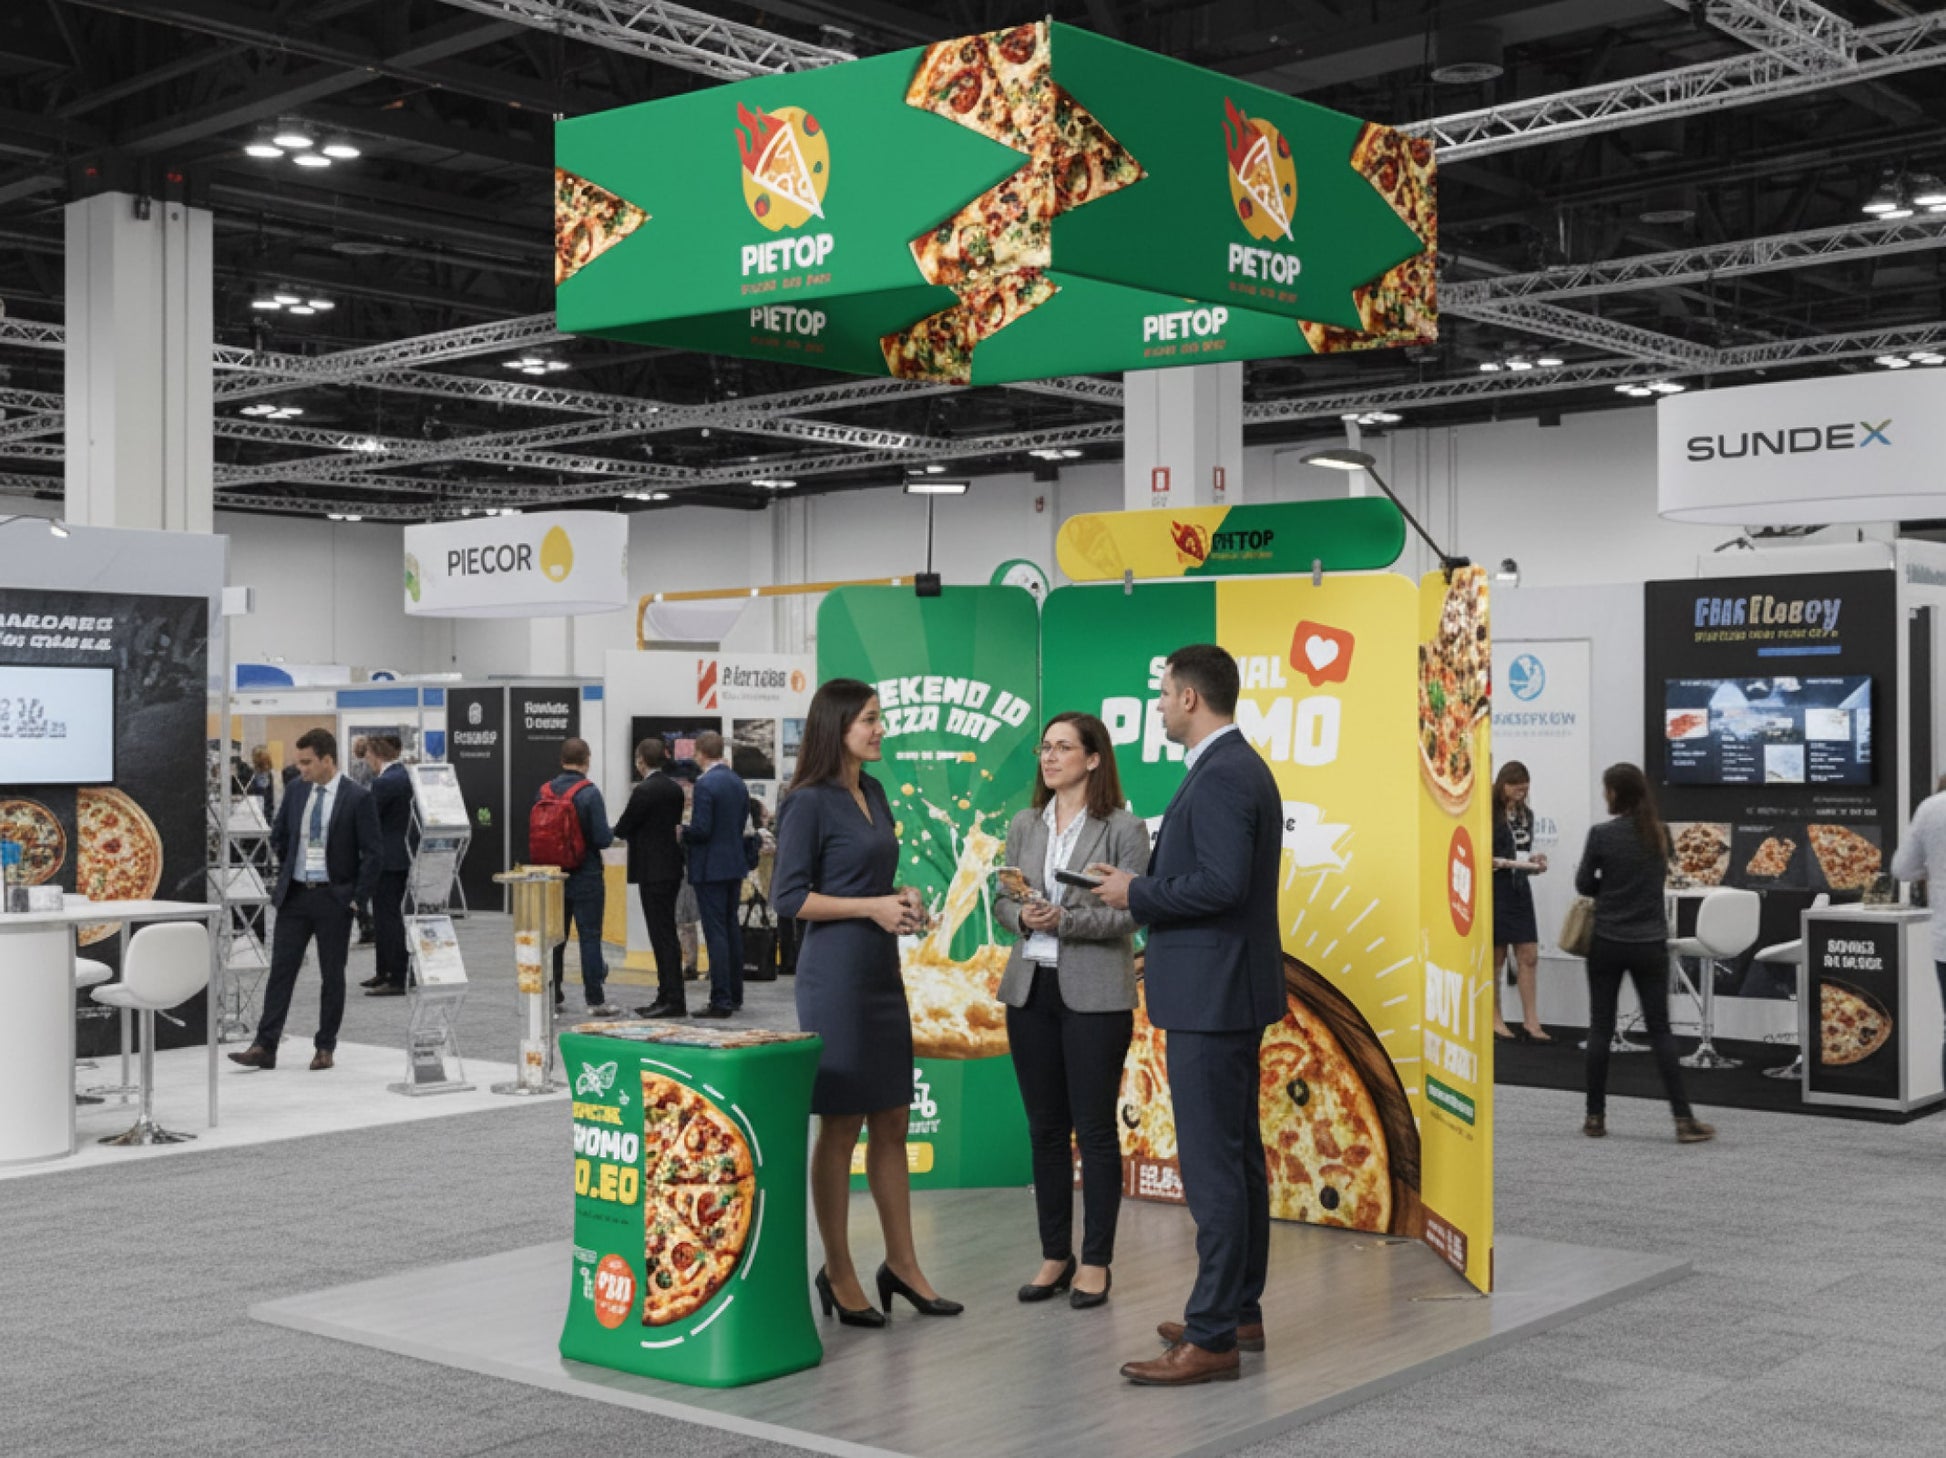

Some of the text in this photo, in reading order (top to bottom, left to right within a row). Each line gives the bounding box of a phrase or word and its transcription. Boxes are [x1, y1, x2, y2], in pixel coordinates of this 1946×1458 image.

[742, 233, 834, 276] PIETOP
[750, 305, 827, 336] PIETOP
[1143, 306, 1229, 342] PIETOP
[1686, 418, 1893, 462] SUNDEX
[447, 542, 532, 577] PIECOR
[1147, 656, 1288, 690] SIAL
[868, 675, 991, 709] EKEND
[1100, 695, 1342, 767] PRMO
